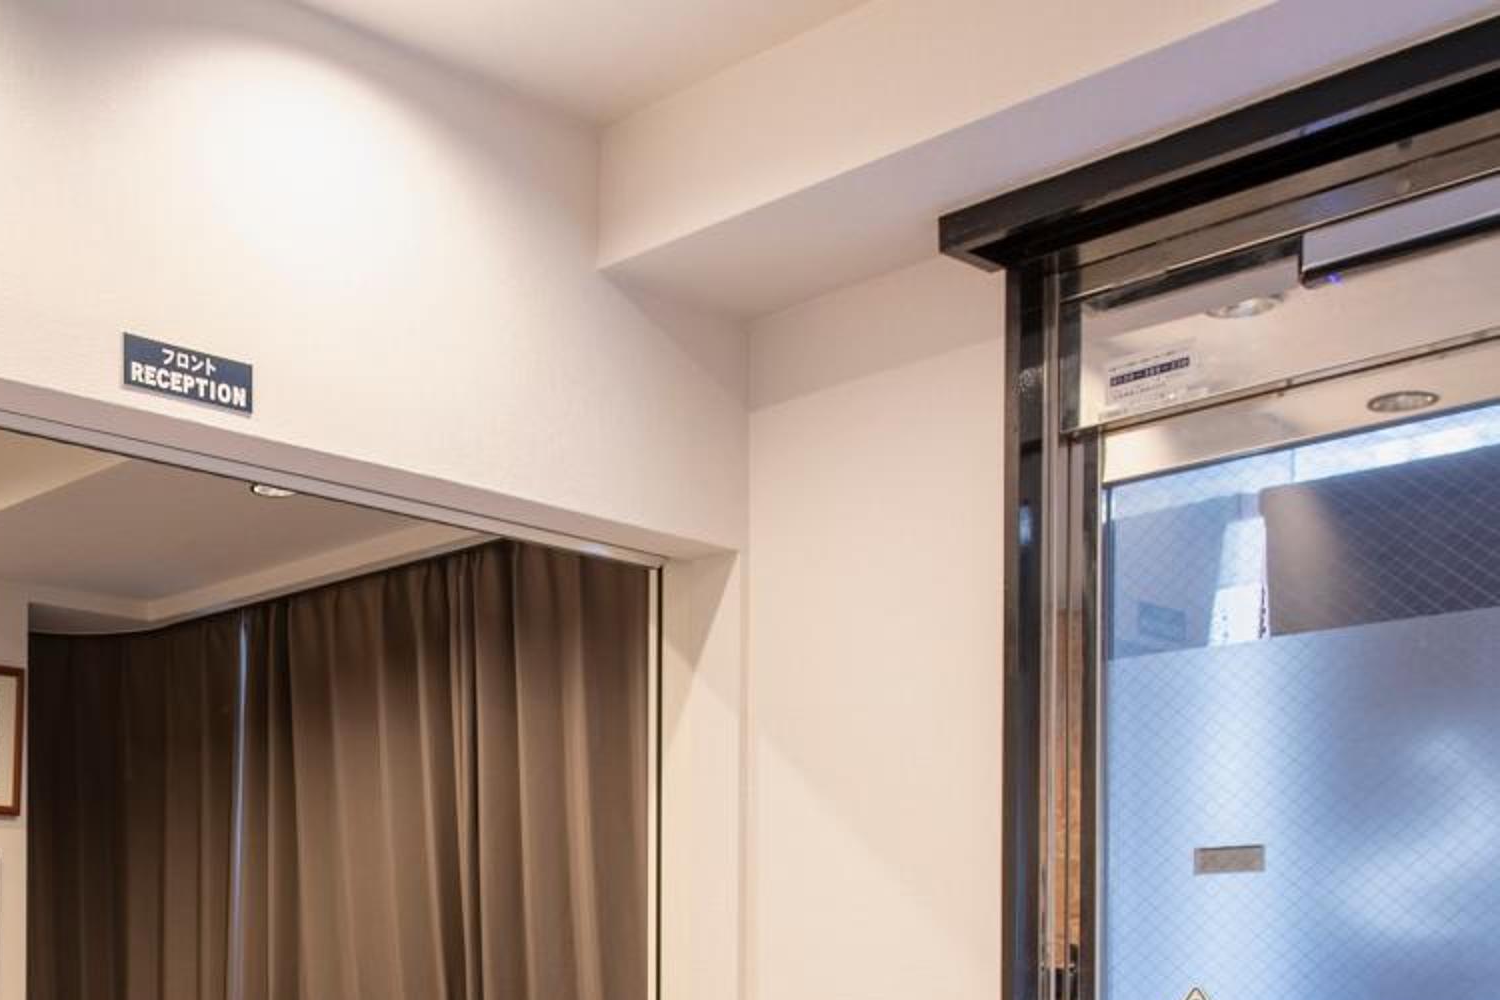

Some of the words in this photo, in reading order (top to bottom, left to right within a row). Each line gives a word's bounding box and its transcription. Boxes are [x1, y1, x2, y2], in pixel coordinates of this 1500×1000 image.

[162, 348, 217, 376] フロント
[131, 361, 247, 407] RECEPTION
